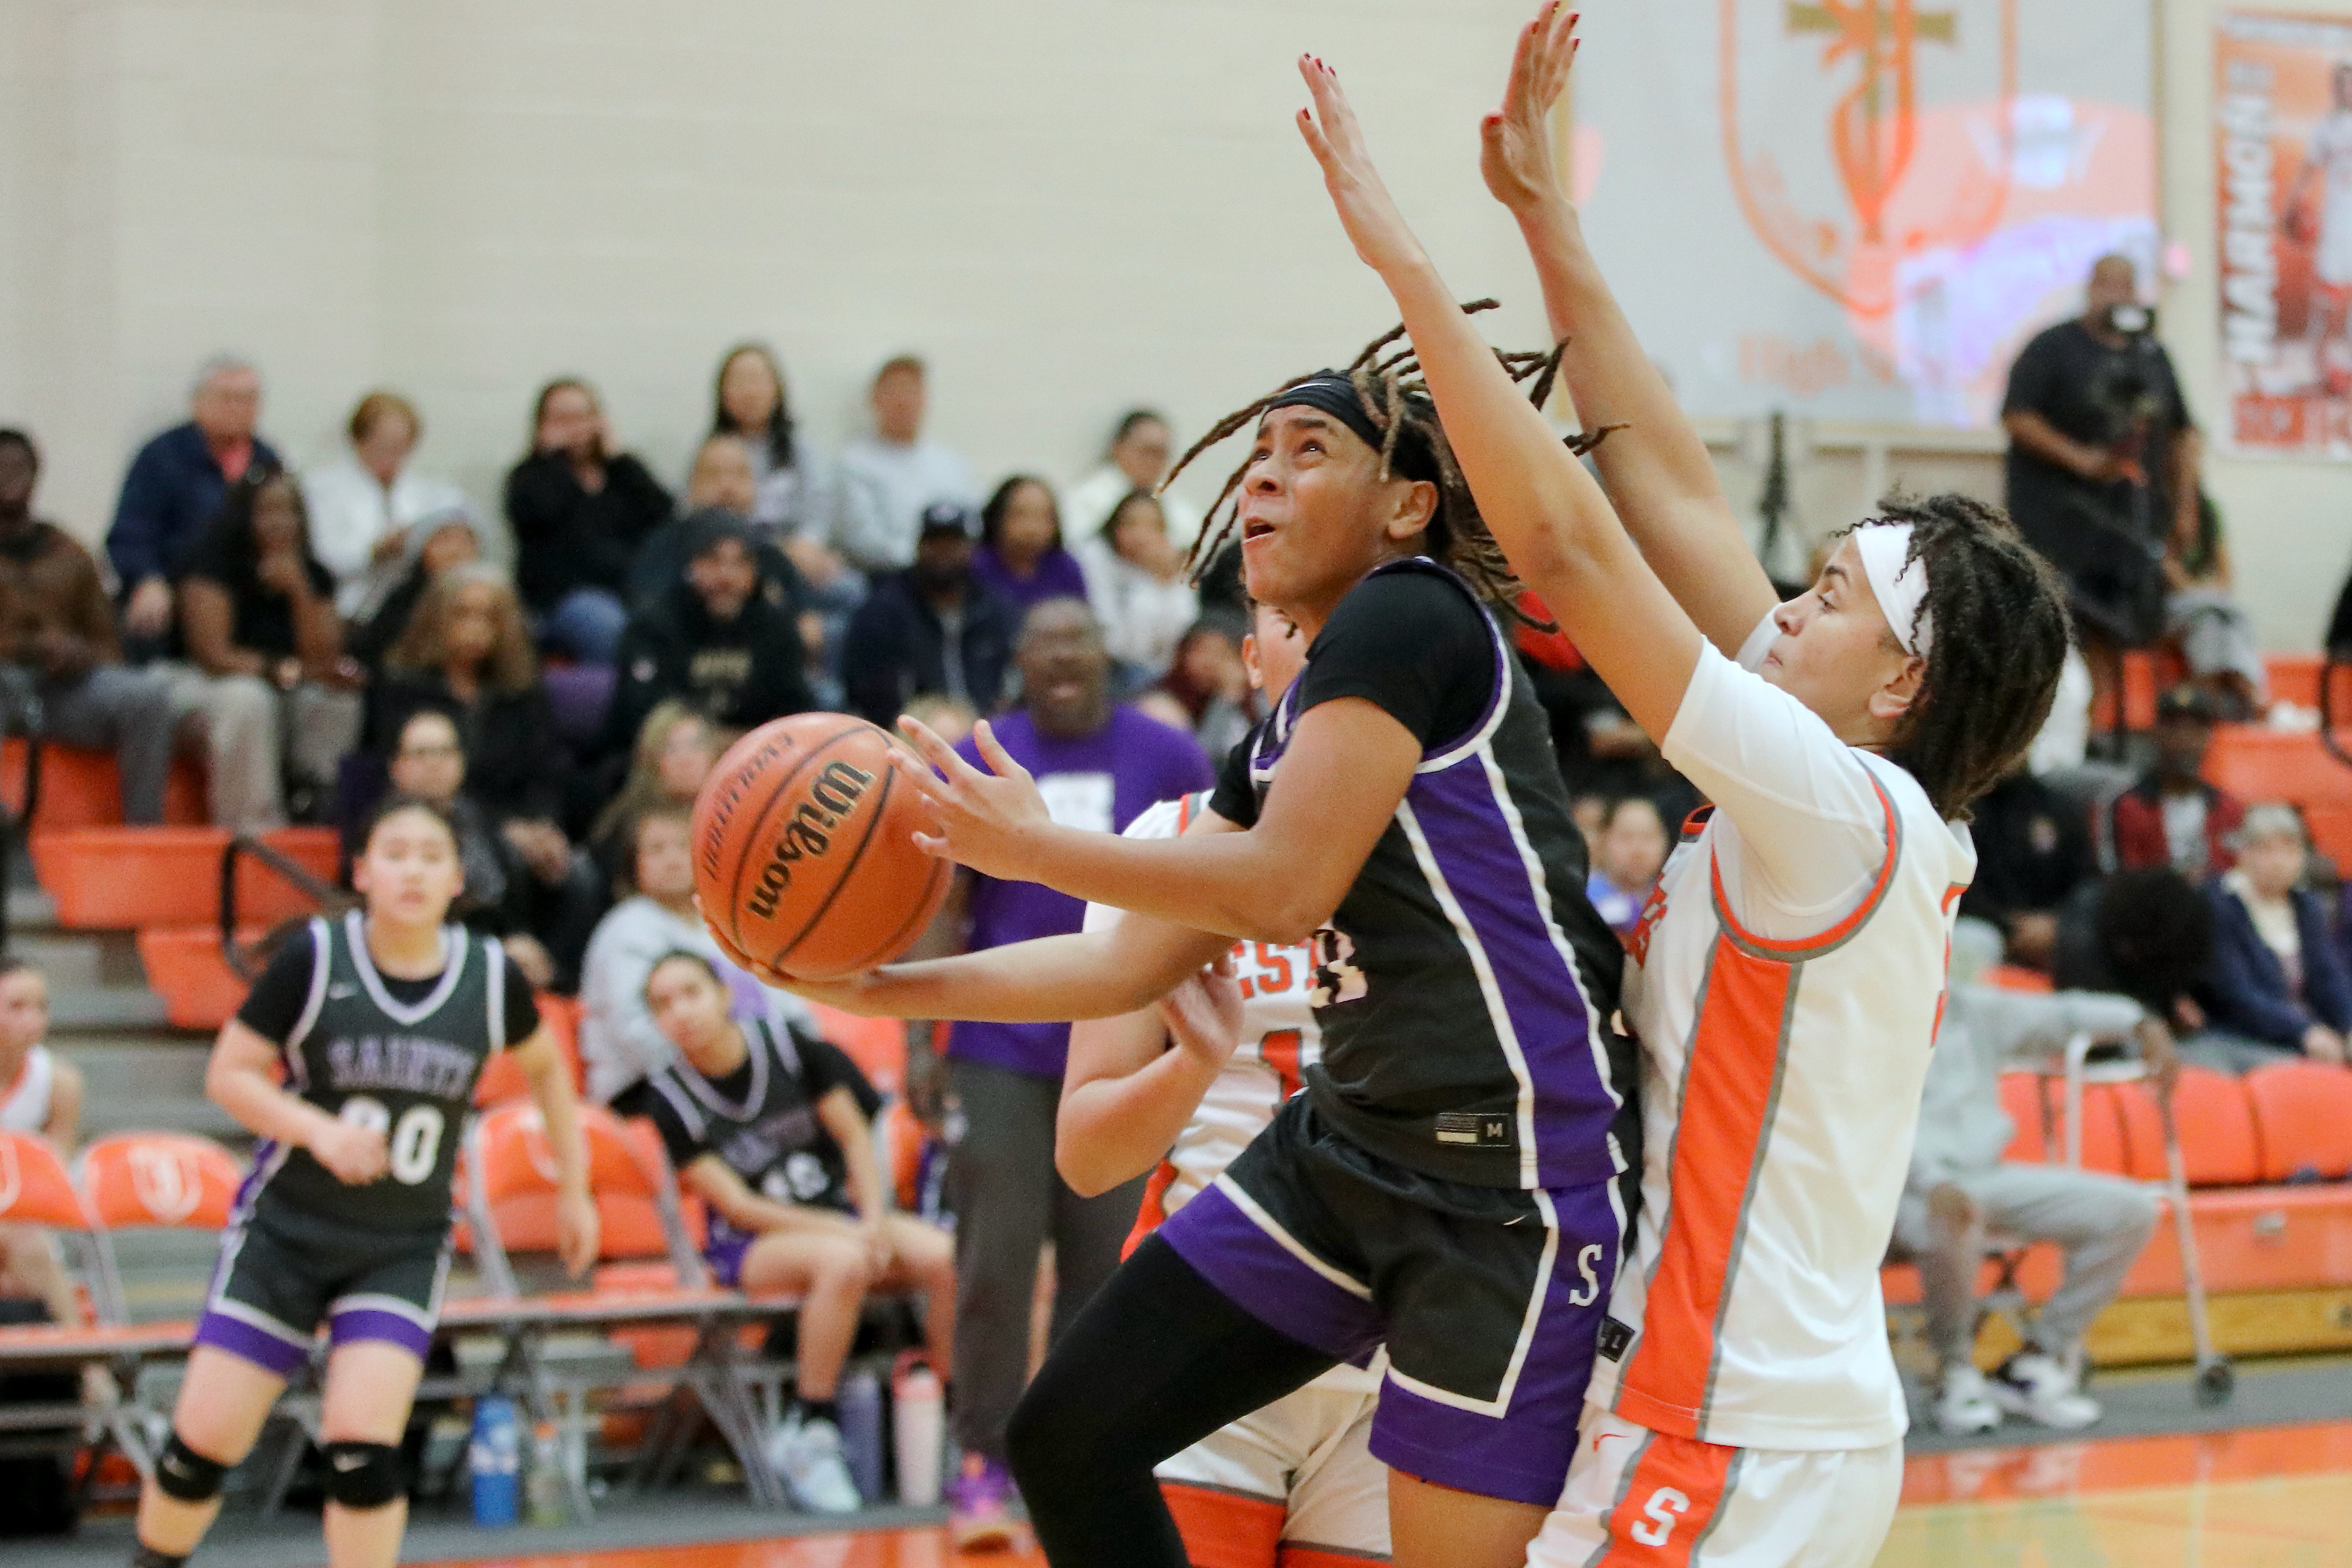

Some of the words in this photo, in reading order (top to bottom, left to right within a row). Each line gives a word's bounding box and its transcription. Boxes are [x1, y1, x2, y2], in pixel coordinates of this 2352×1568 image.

[747, 760, 877, 922] Wilson
[1487, 1122, 1504, 1138] M
[1569, 1244, 1602, 1307] S
[1631, 1486, 1690, 1547] S
